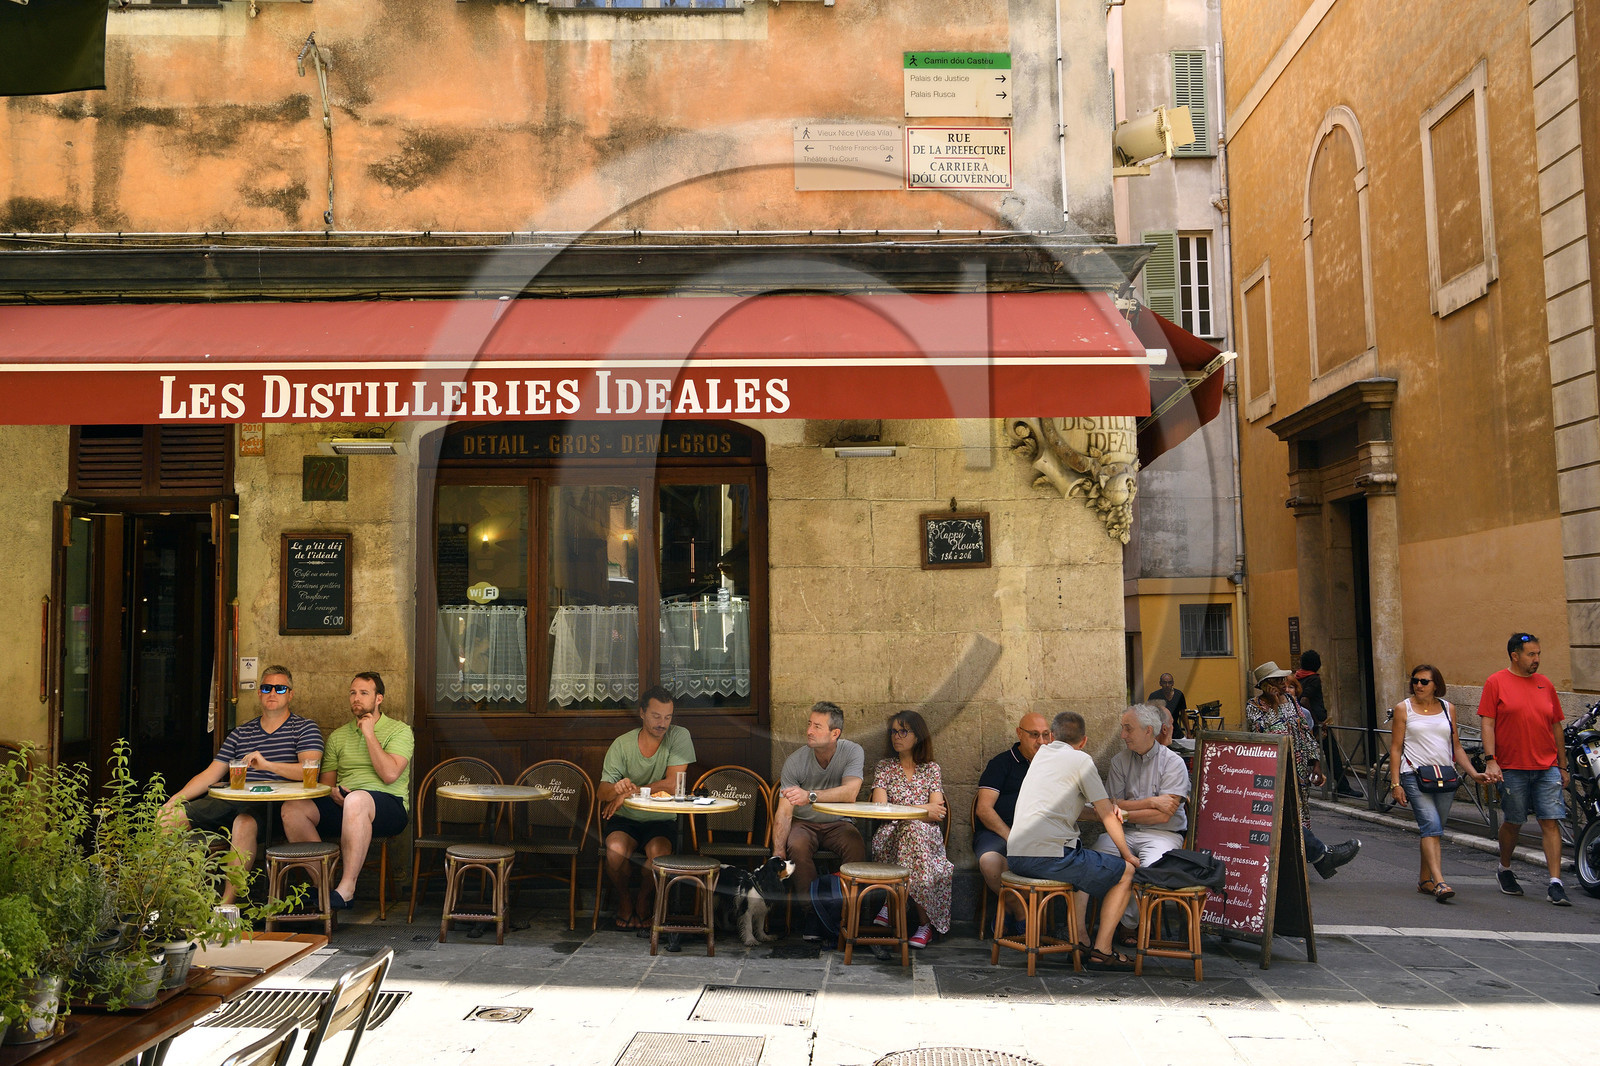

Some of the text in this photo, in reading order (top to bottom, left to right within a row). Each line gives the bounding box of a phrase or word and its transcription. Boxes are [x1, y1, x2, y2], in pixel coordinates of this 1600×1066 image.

[924, 57, 949, 65] Camin
[948, 133, 970, 143] RUE
[913, 145, 1006, 155] DE LA PREFECTURE
[930, 162, 989, 172] CARRIERA
[912, 172, 1007, 184] DÓU GOUVÈRNOU
[159, 370, 791, 419] LES DISTILLERIES IDEALES
[463, 434, 529, 456] DETAIL
[549, 434, 601, 454] GROS
[305, 462, 346, 497] illy
[932, 528, 966, 543] Happy
[290, 541, 343, 552] Le p'tit déj
[949, 540, 980, 551] Hours
[293, 568, 312, 579] Café
[1234, 745, 1277, 758] Distilleries
[1255, 778, 1273, 788] 5.80
[711, 790, 752, 799] Distilleries
[1252, 803, 1273, 813] 11.00
[1250, 833, 1269, 842] 11.00
[1231, 857, 1259, 866] pression
[1228, 882, 1253, 897] whisky
[1223, 896, 1253, 908] ocktails
